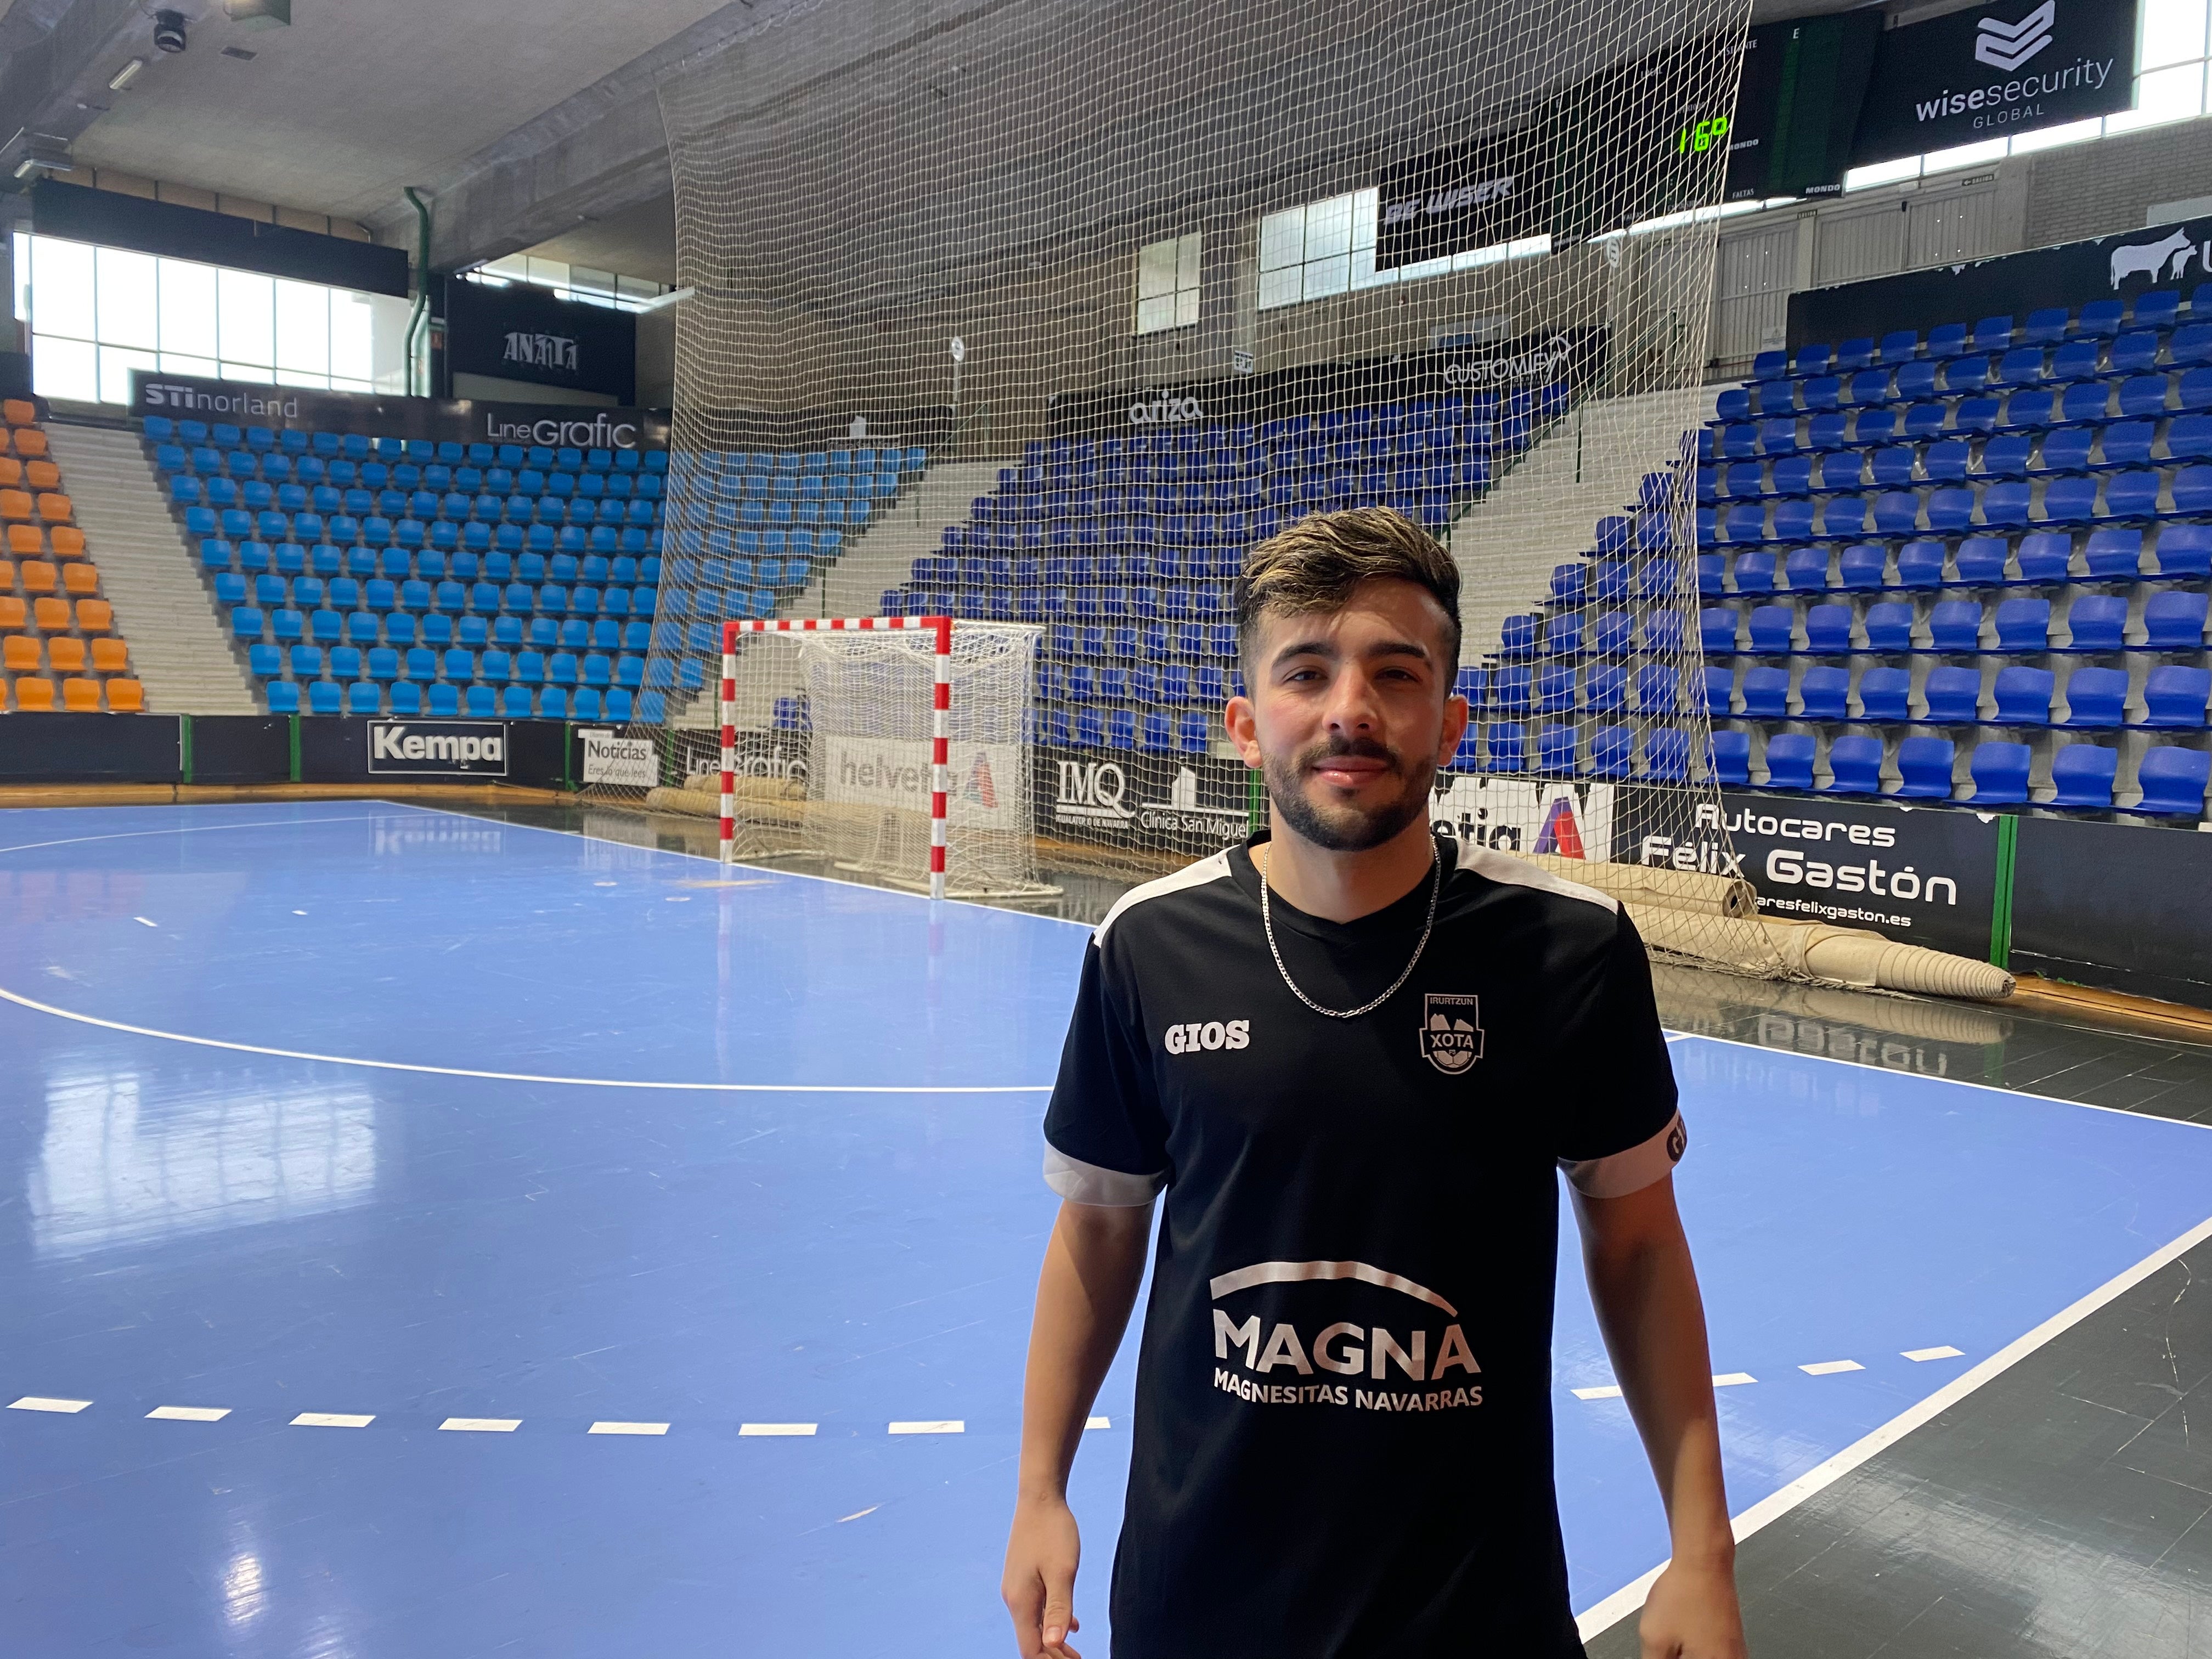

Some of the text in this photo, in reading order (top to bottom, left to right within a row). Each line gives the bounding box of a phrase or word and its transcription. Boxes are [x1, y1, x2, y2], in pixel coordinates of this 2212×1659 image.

[1916, 58, 2114, 122] wisesecurity
[1973, 103, 2045, 129] GLOBAL
[1383, 176, 1513, 225] BE WISER
[1732, 189, 1754, 200] FALTAS
[1805, 184, 1841, 194] MONDO
[1129, 390, 1204, 424] ariza
[373, 725, 503, 769] Kempa
[588, 740, 647, 760] Noticias
[588, 764, 603, 775] Eres
[1056, 760, 1136, 819] IMQ
[1141, 811, 1249, 841] Clínica San Miguel
[1695, 803, 1896, 848] Autocares
[1641, 835, 1957, 906] Félix Gastón
[1755, 895, 1911, 927] aresfelixgaston.es
[1430, 996, 1474, 1006] IRURTZUN
[1164, 1019, 1250, 1055] GIOS
[1430, 1033, 1474, 1049] XOTA
[1212, 1308, 1482, 1381] MAGNA
[1214, 1367, 1483, 1412] MAGNESITAS NAVARRAS
